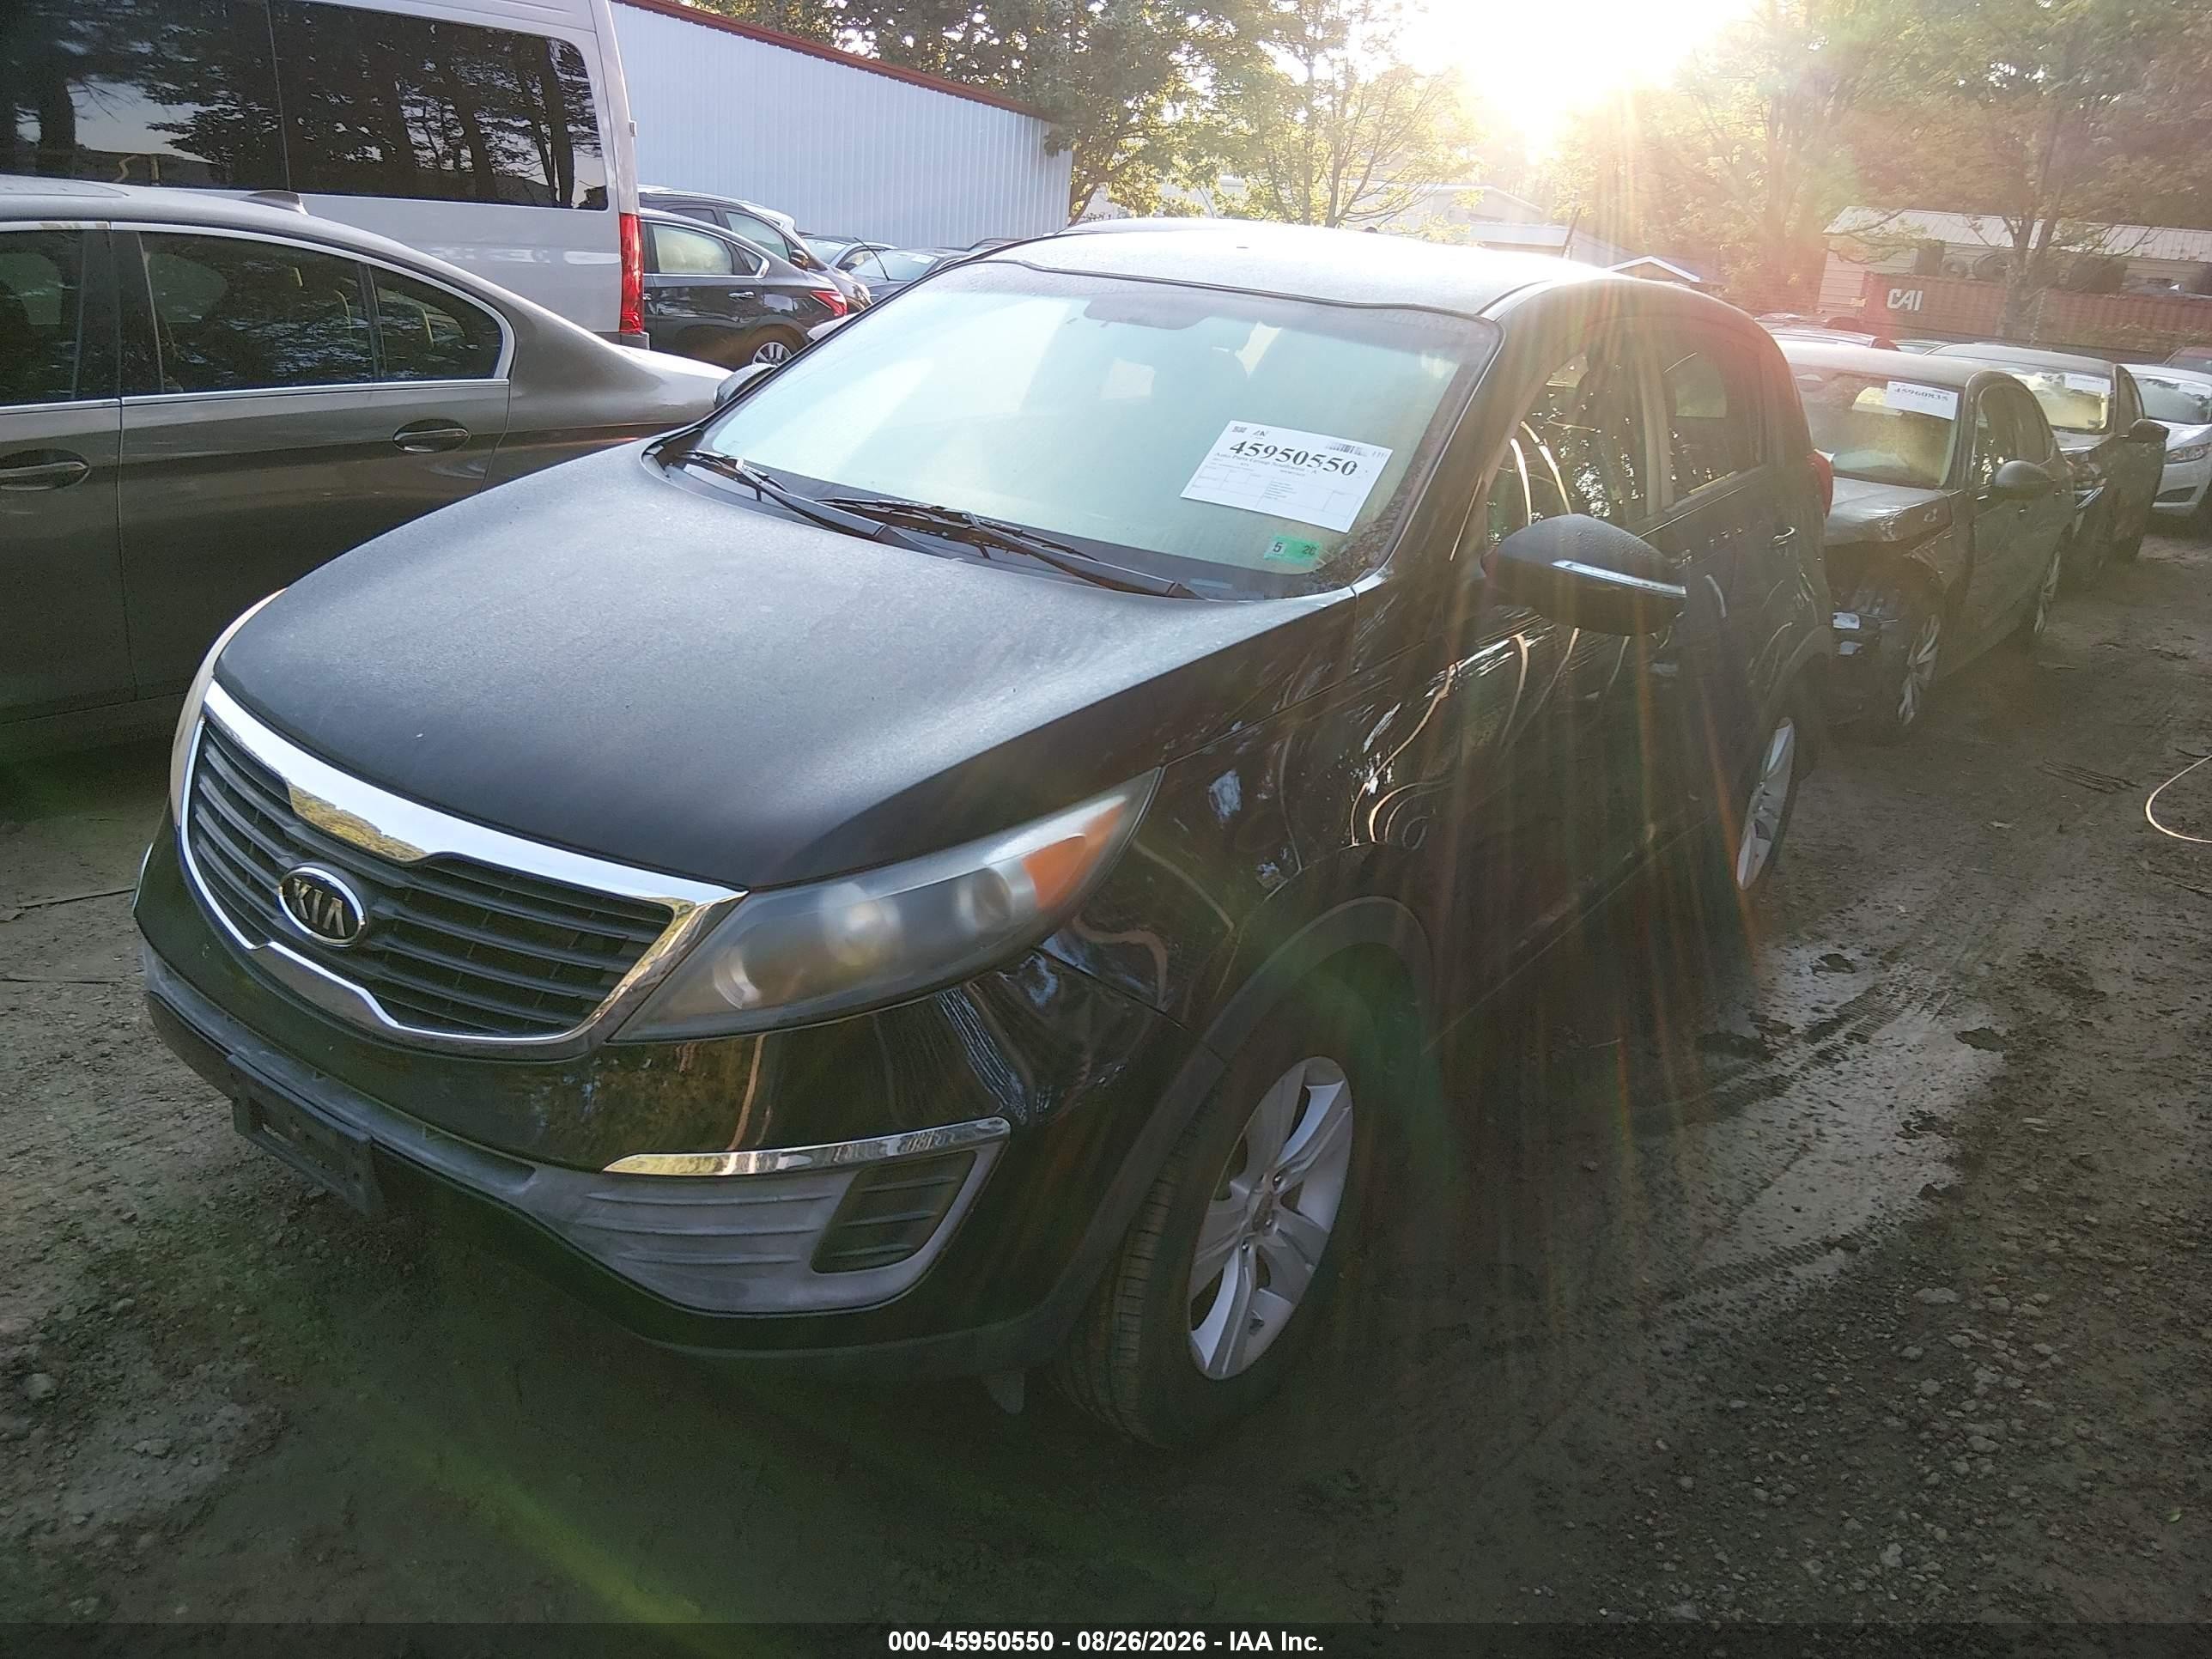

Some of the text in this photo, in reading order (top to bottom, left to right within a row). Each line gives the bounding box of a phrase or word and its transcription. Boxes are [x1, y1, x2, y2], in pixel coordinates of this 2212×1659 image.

[1887, 289, 1923, 311] CAI
[1229, 441, 1358, 476] 45950550
[1273, 542, 1284, 553] 5
[292, 878, 345, 937] KIA
